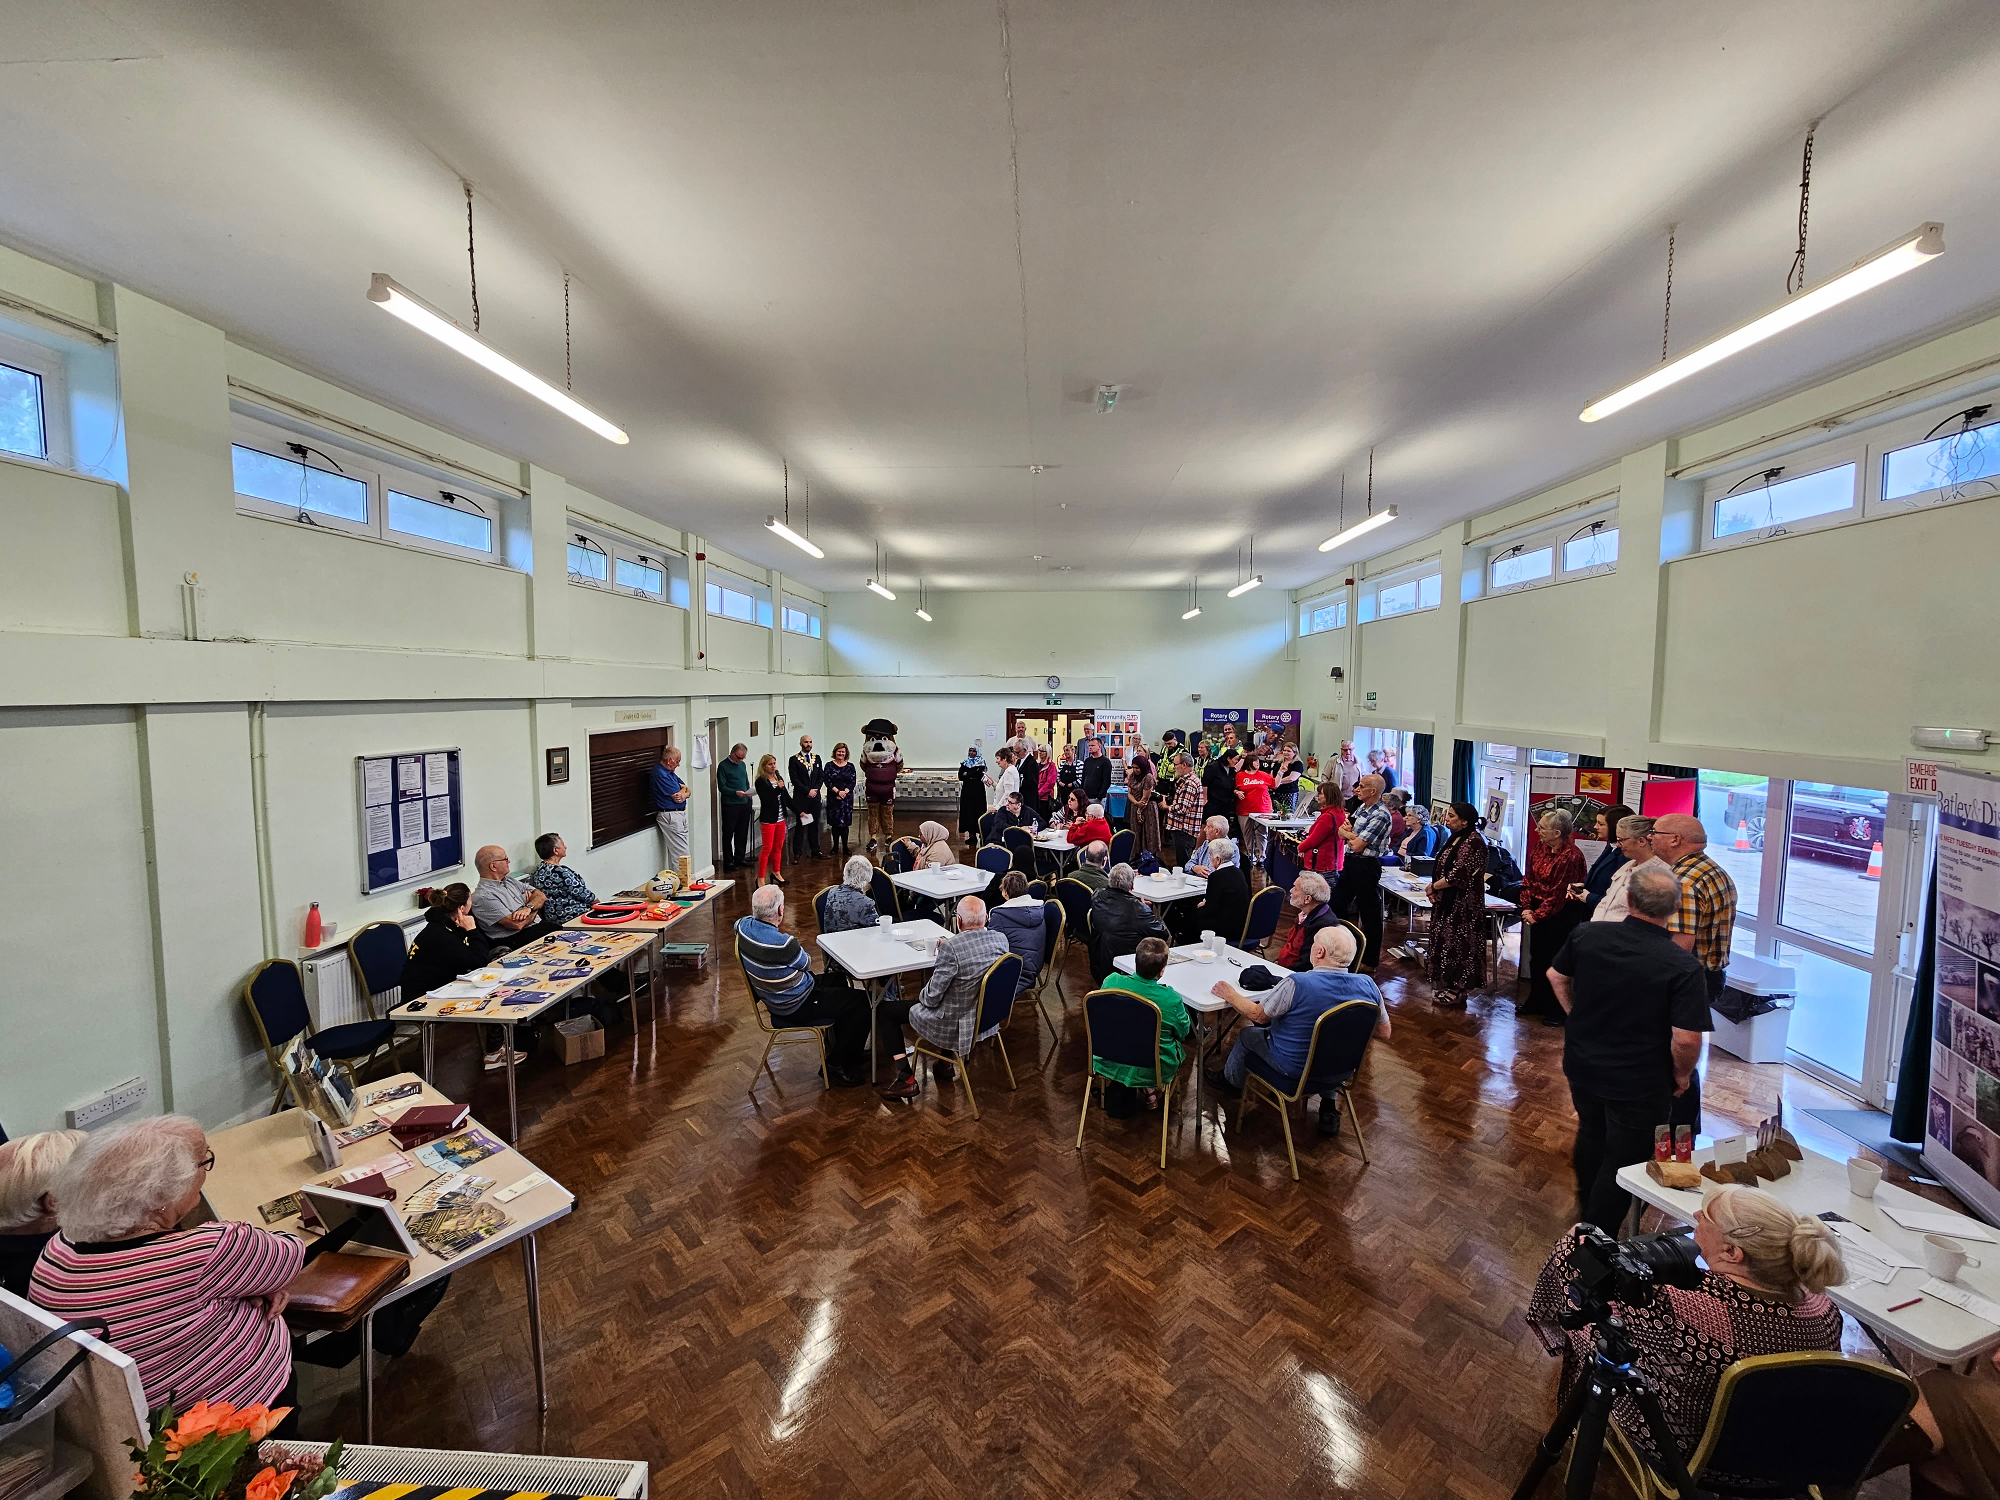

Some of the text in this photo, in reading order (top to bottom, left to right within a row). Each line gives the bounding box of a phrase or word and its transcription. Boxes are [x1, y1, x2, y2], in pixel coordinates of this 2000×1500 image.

[1910, 777, 1928, 790] EXIT
[1943, 836, 1955, 844] MEET
[1956, 839, 1977, 850] TUESDAY
